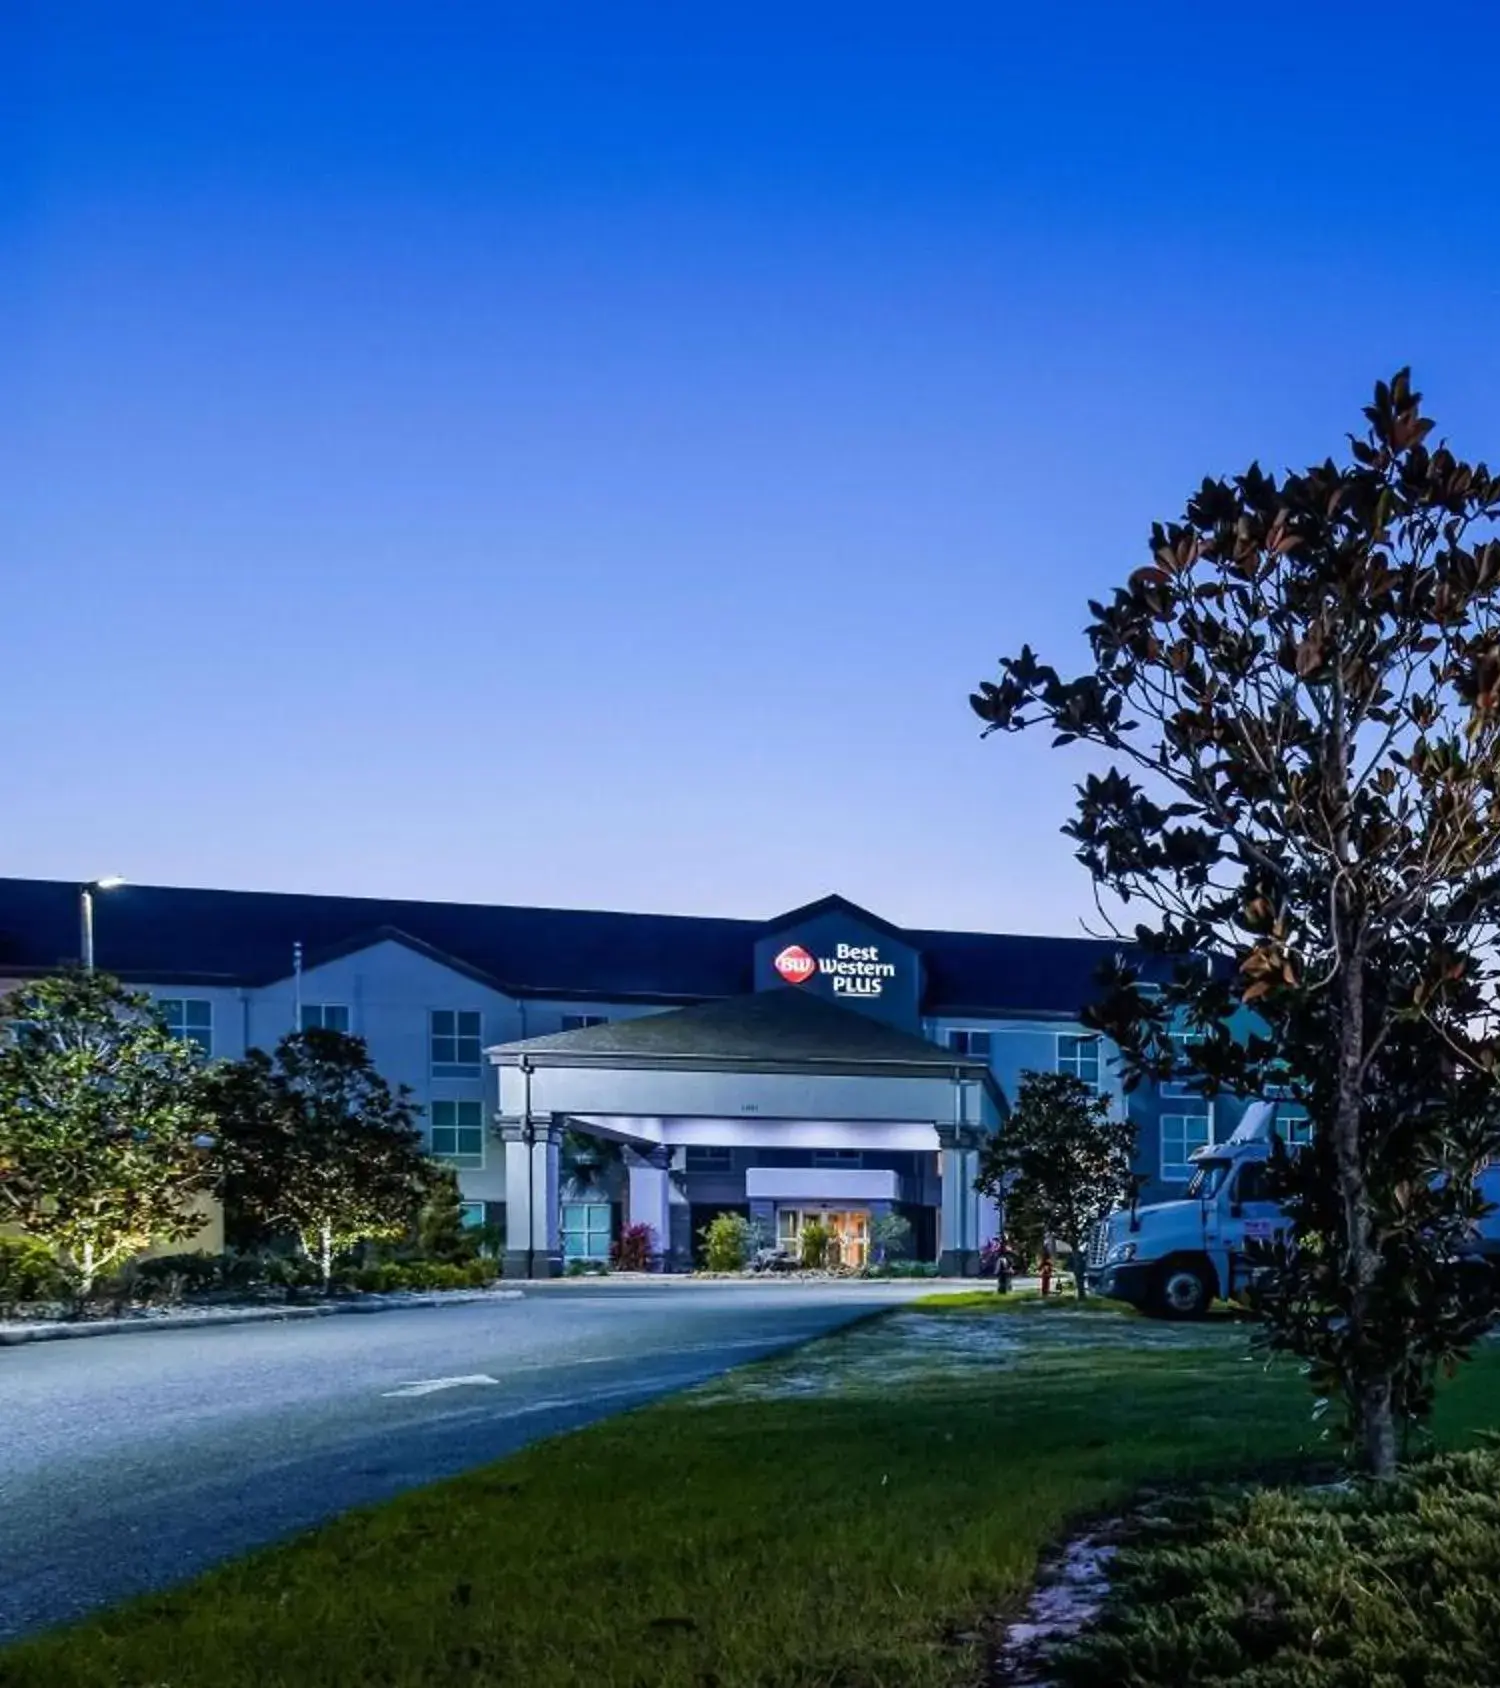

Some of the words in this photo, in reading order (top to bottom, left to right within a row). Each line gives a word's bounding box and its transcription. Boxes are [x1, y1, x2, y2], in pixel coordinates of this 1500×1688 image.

[836, 943, 879, 962] Best
[780, 956, 812, 972] BW
[818, 957, 895, 977] Western
[833, 975, 883, 993] PLUS
